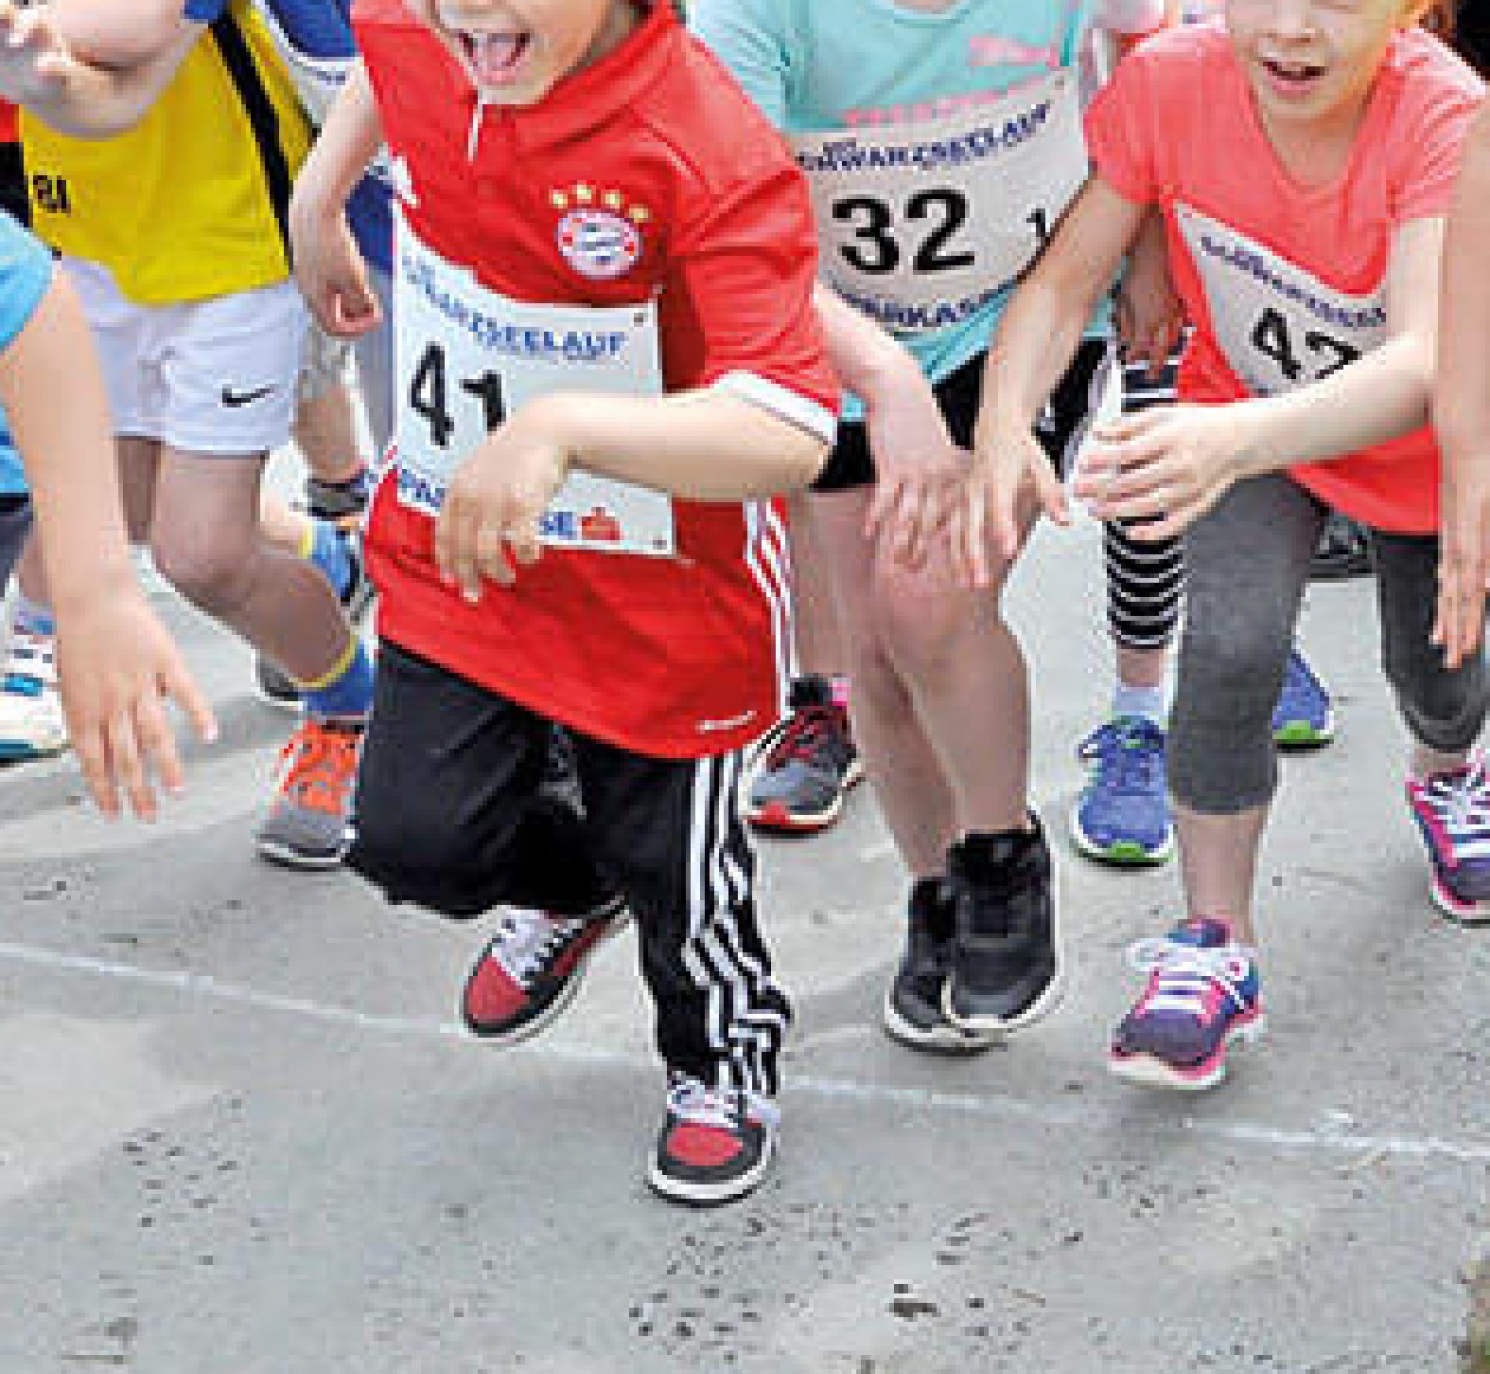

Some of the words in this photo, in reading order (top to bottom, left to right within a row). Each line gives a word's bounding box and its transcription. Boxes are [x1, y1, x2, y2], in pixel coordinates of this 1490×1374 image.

[831, 189, 975, 274] 32
[1251, 306, 1361, 380] 42
[409, 342, 508, 450] 41
